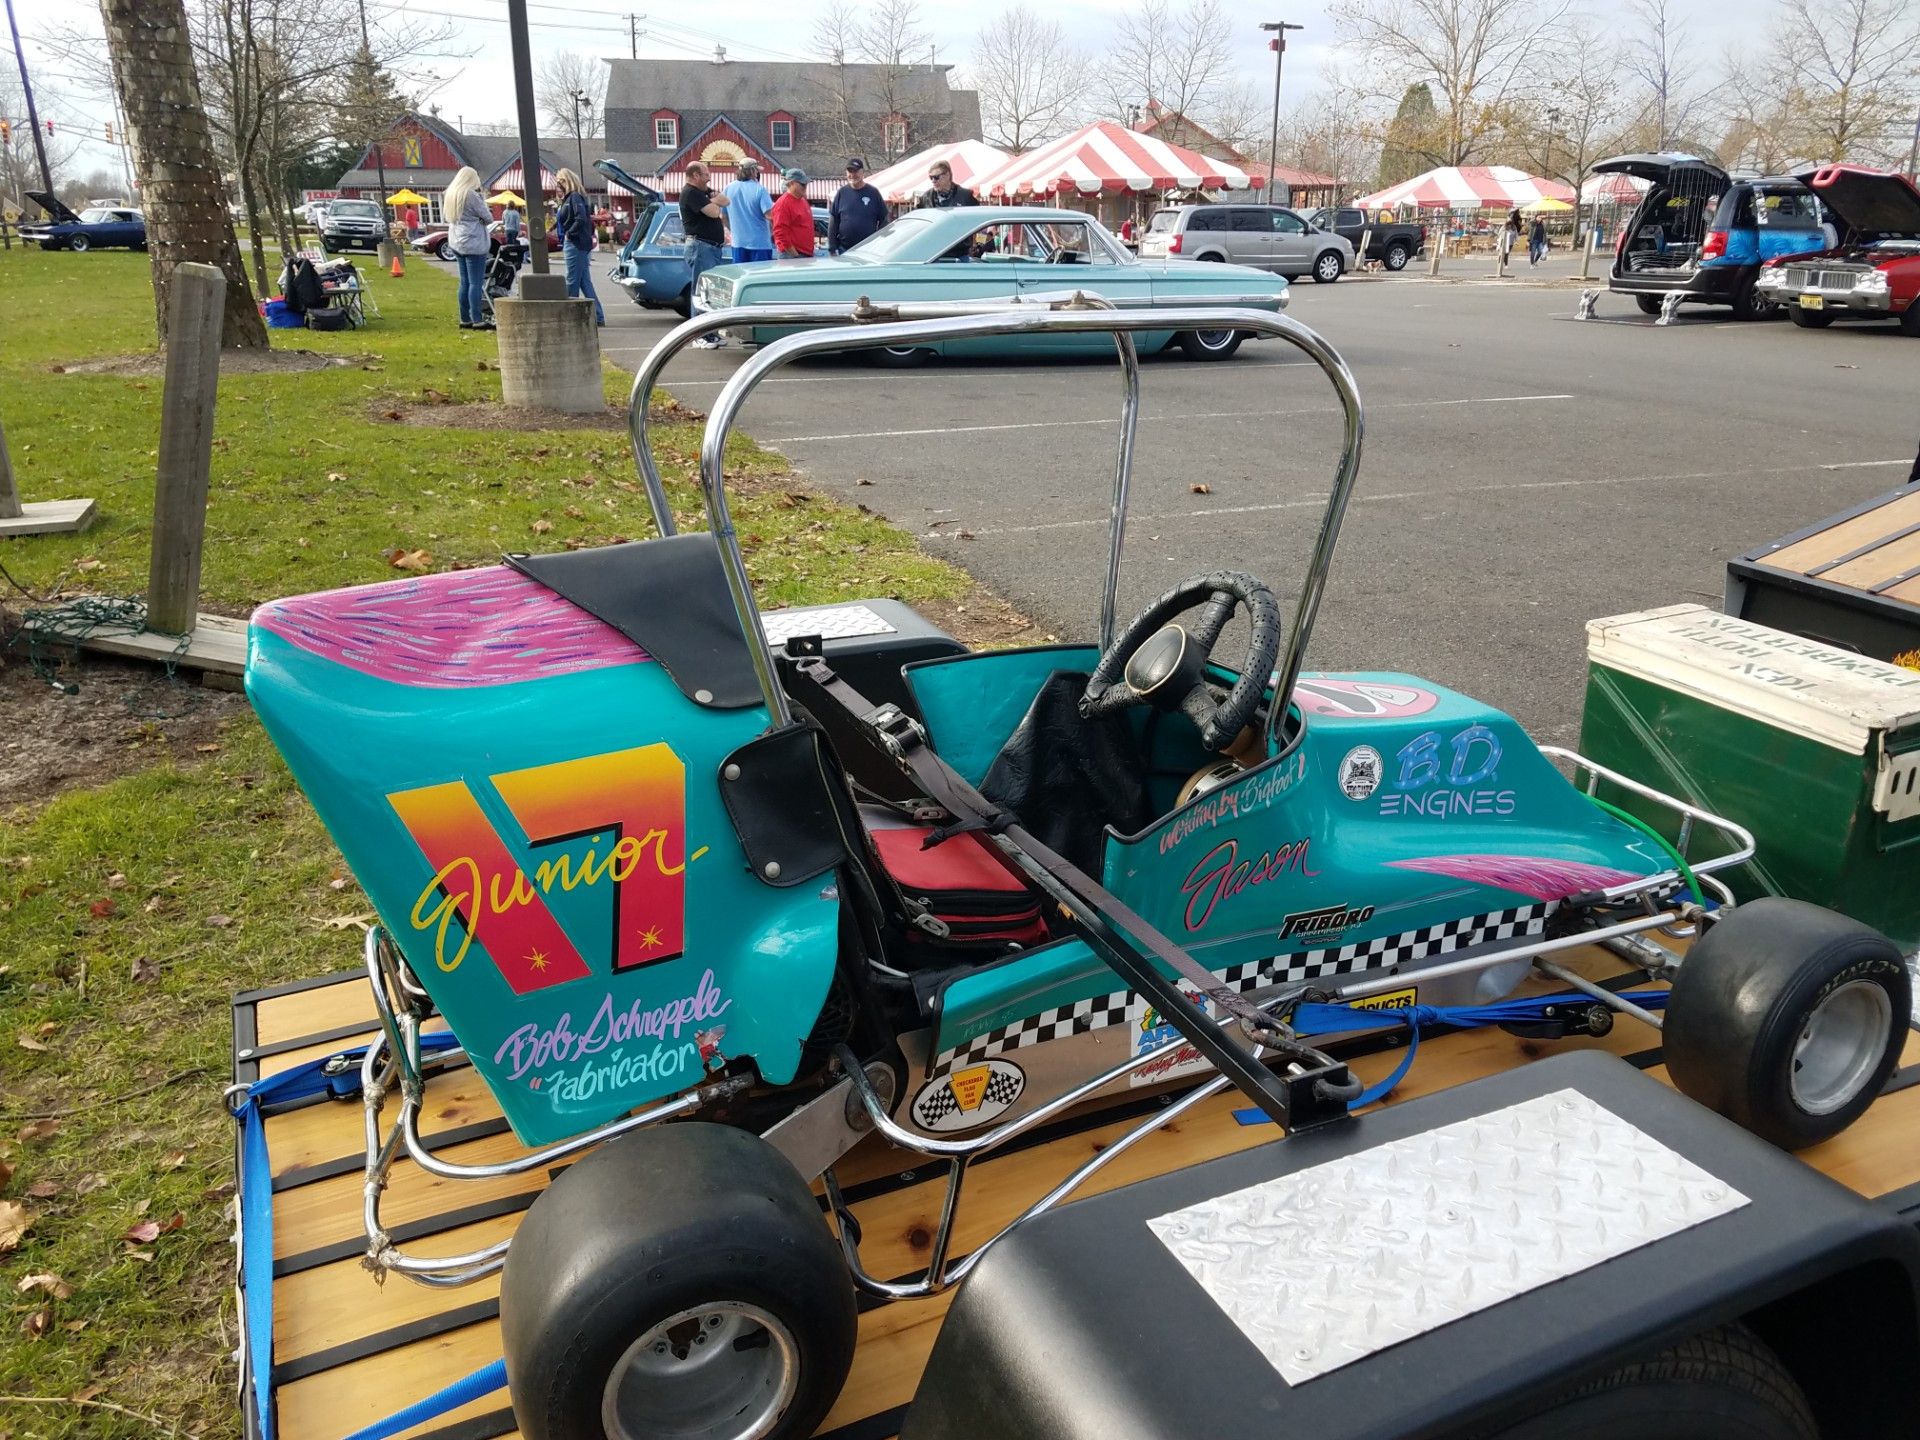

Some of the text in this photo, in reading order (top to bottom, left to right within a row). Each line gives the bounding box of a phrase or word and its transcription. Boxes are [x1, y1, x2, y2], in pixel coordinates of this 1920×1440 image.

[1217, 789, 1239, 818] by
[1380, 790, 1516, 820] ENGINES
[385, 741, 686, 996] 17
[1181, 836, 1321, 932] Jason
[494, 1012, 578, 1080] Bob
